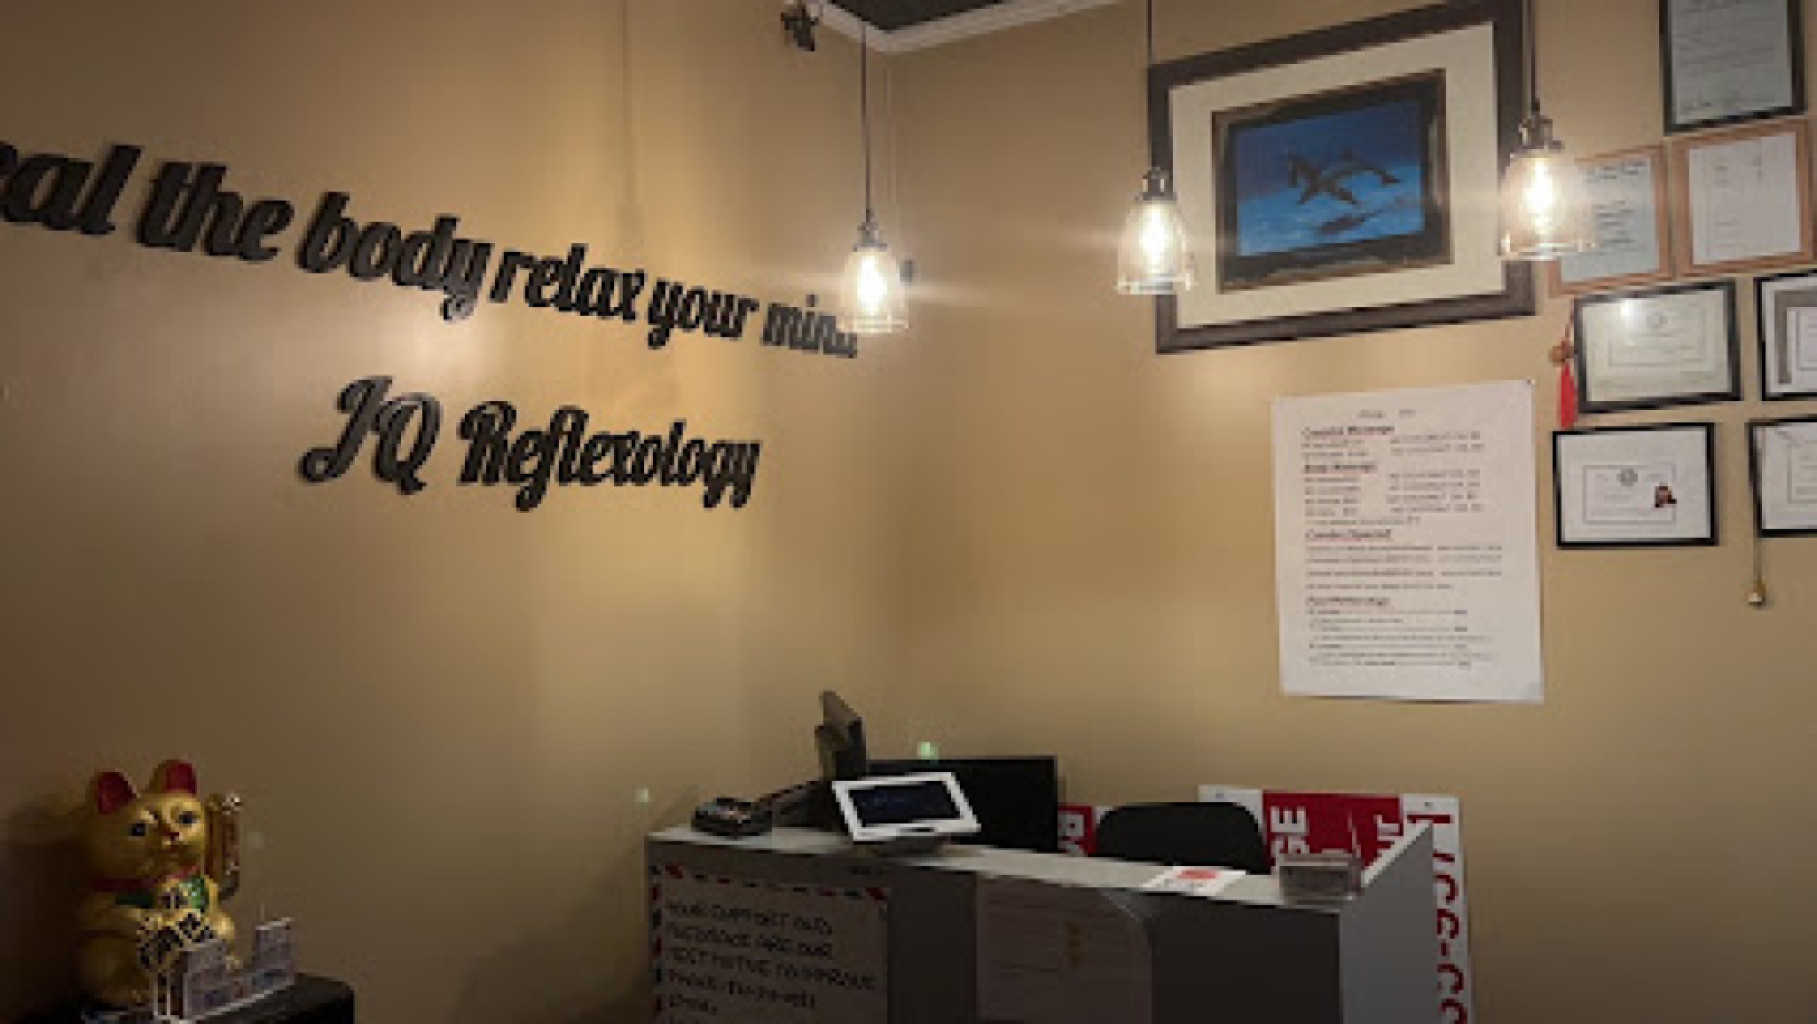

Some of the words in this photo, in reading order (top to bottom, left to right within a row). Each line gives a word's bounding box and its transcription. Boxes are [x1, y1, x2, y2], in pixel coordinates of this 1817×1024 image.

[137, 161, 294, 262] the
[298, 191, 493, 320] body
[489, 243, 646, 322] relax
[647, 278, 760, 350] your
[298, 375, 441, 495] JQ
[456, 400, 762, 511] Reflexology
